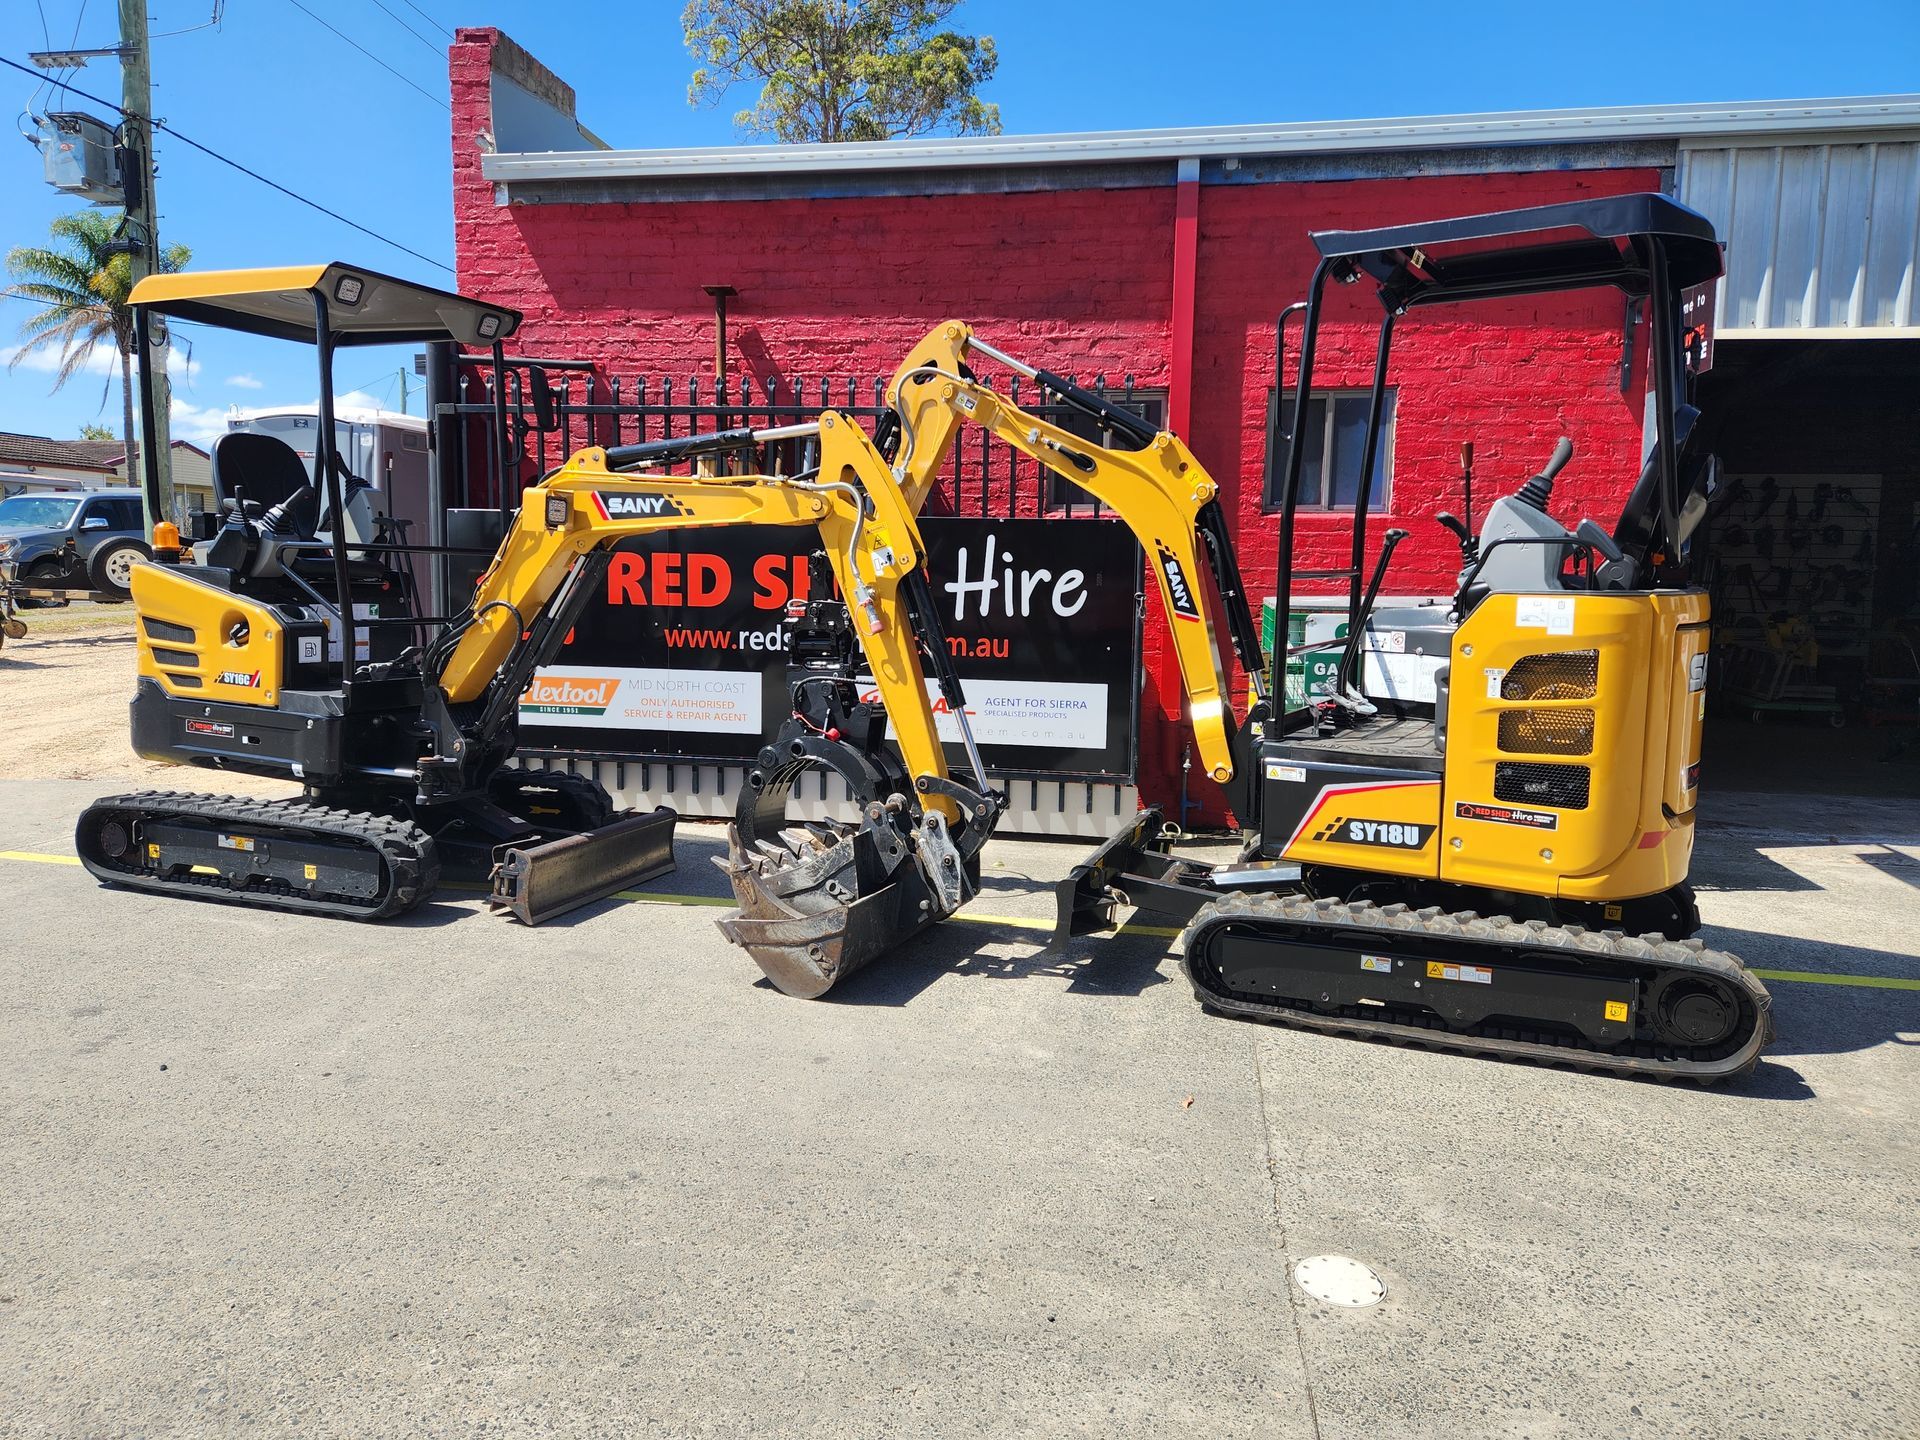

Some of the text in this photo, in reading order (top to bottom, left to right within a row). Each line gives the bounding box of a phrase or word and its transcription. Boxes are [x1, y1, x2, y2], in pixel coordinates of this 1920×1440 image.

[608, 497, 665, 513] SANY
[607, 551, 732, 607] RED
[944, 534, 1088, 621] Hire
[1165, 560, 1190, 608] SANY
[1314, 662, 1338, 675] GA
[224, 672, 250, 685] SY16C
[628, 679, 746, 694] MID NORTH COAST
[640, 698, 735, 709] ONLY AUTHORISED
[985, 697, 1021, 708] AGENT
[1025, 698, 1046, 708] FOR
[1050, 699, 1088, 710] SIERRA
[624, 709, 748, 722] SERVICE & REPAIR AGENT
[984, 709, 1067, 719] SPECIALISED PRODUCTS
[1512, 810, 1534, 821] Hire
[1349, 821, 1419, 846] SY18U
